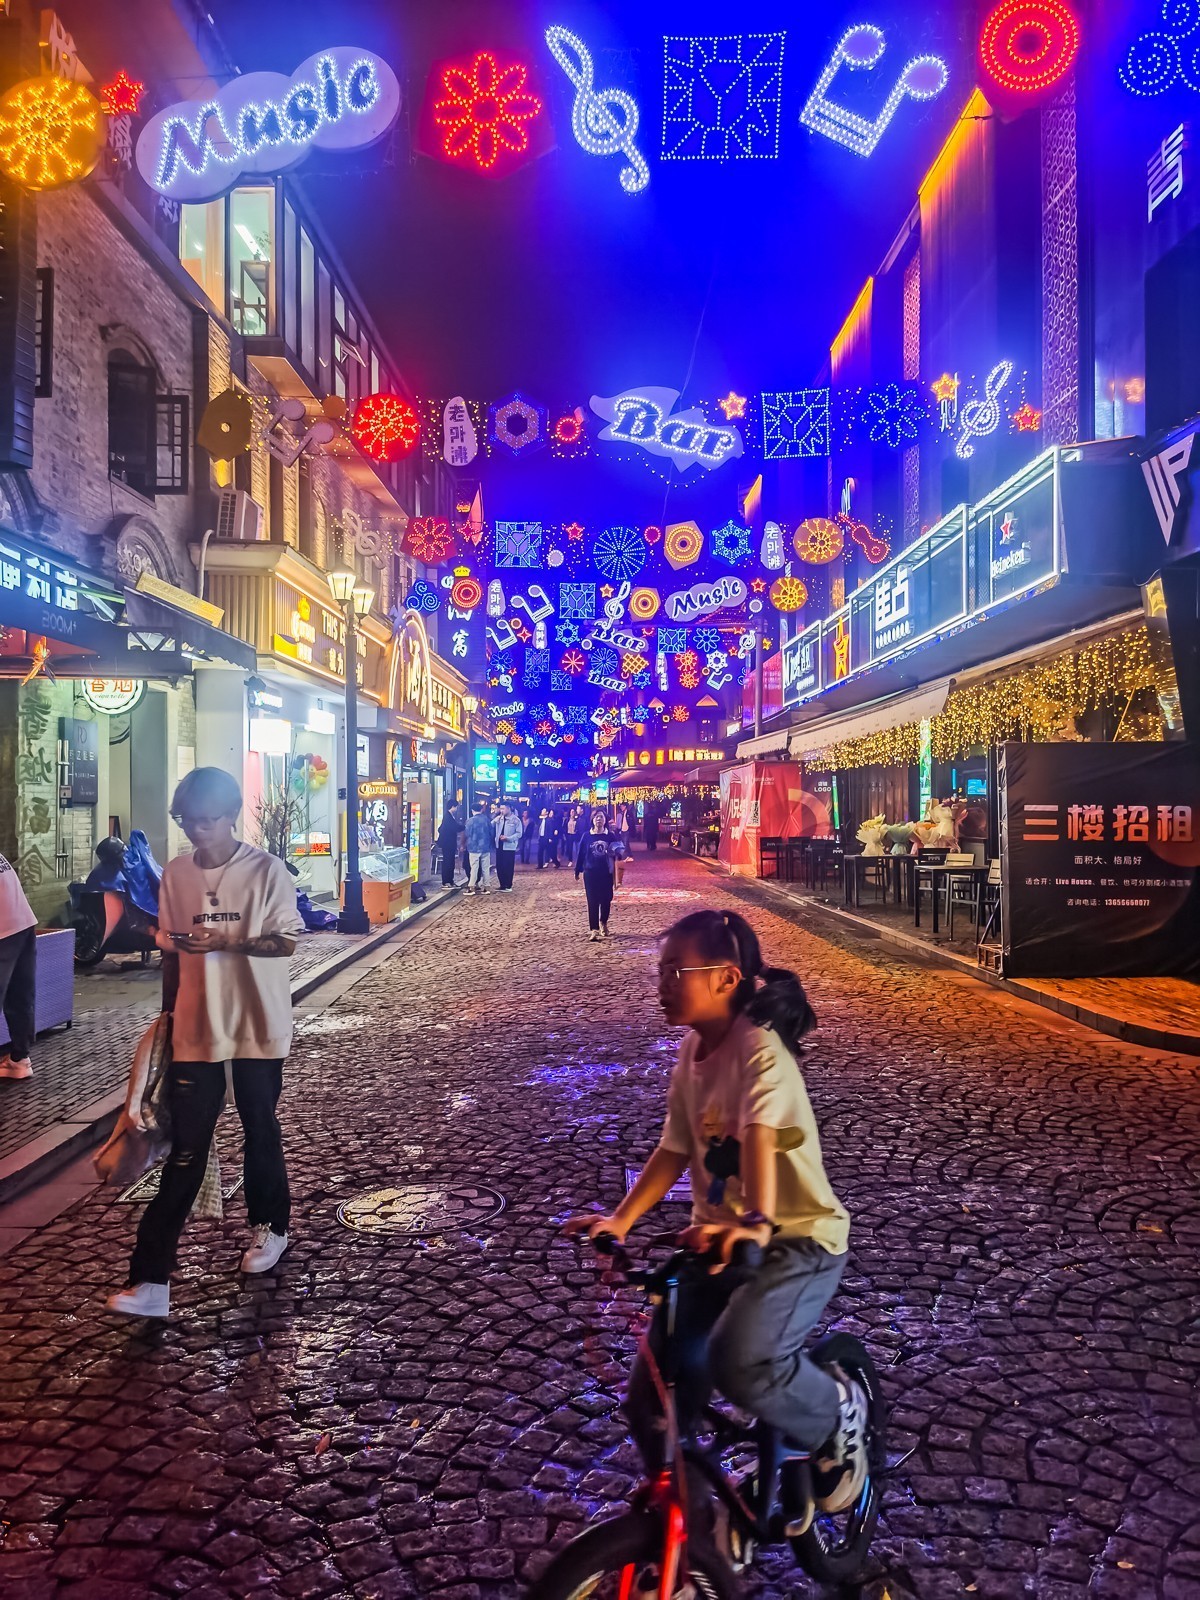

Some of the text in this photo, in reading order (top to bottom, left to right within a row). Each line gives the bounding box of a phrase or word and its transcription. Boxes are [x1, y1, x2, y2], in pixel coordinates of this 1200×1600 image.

[155, 54, 380, 189] Music
[610, 396, 736, 460] Bar
[991, 548, 1025, 577] Heineken
[672, 579, 741, 618] Music
[592, 621, 646, 652] Bar
[588, 670, 627, 692] Bar
[489, 701, 524, 718] Music
[359, 783, 398, 797] Corona
[1023, 804, 1194, 842] 三楼招租
[1074, 855, 1142, 865] 面积大、格局好
